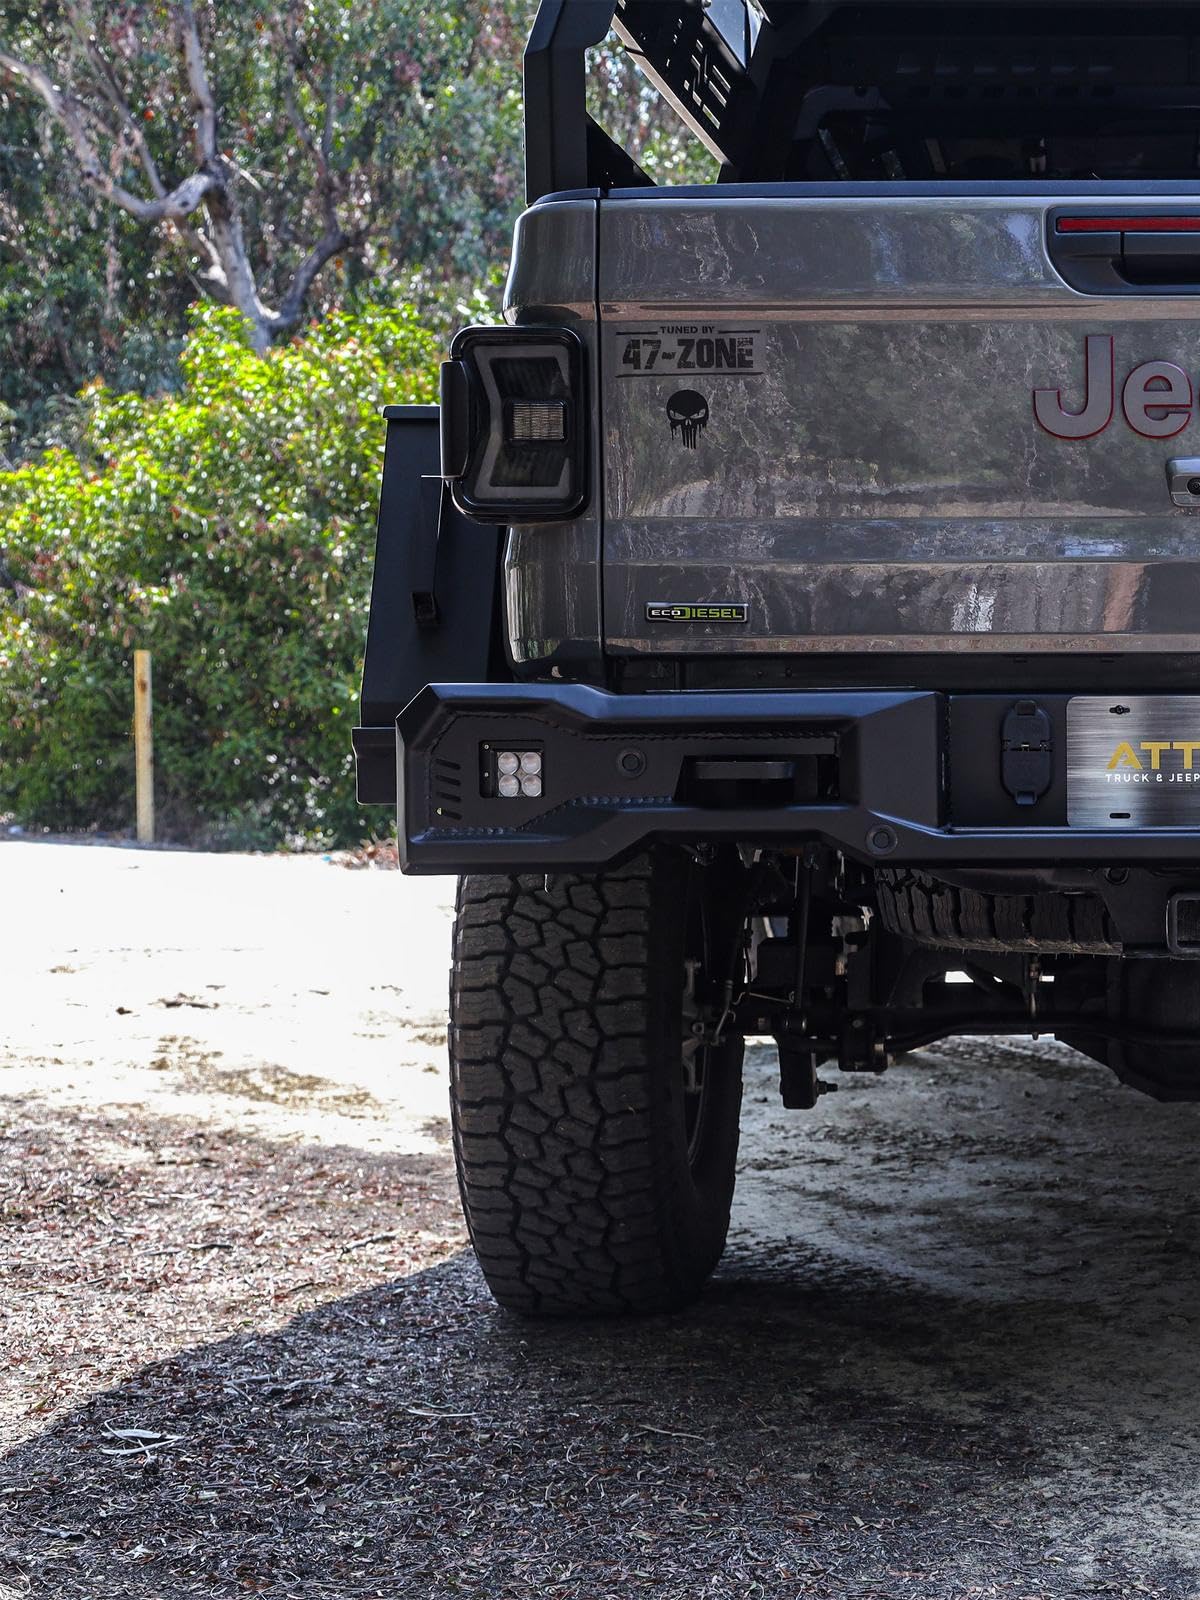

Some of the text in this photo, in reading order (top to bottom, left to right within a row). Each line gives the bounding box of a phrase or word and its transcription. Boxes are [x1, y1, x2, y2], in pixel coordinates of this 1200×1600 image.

[660, 325, 715, 334] TUNED BY
[1105, 773, 1150, 783] TRUCK
[1156, 773, 1163, 783] &
[1169, 773, 1200, 783] JEEP
